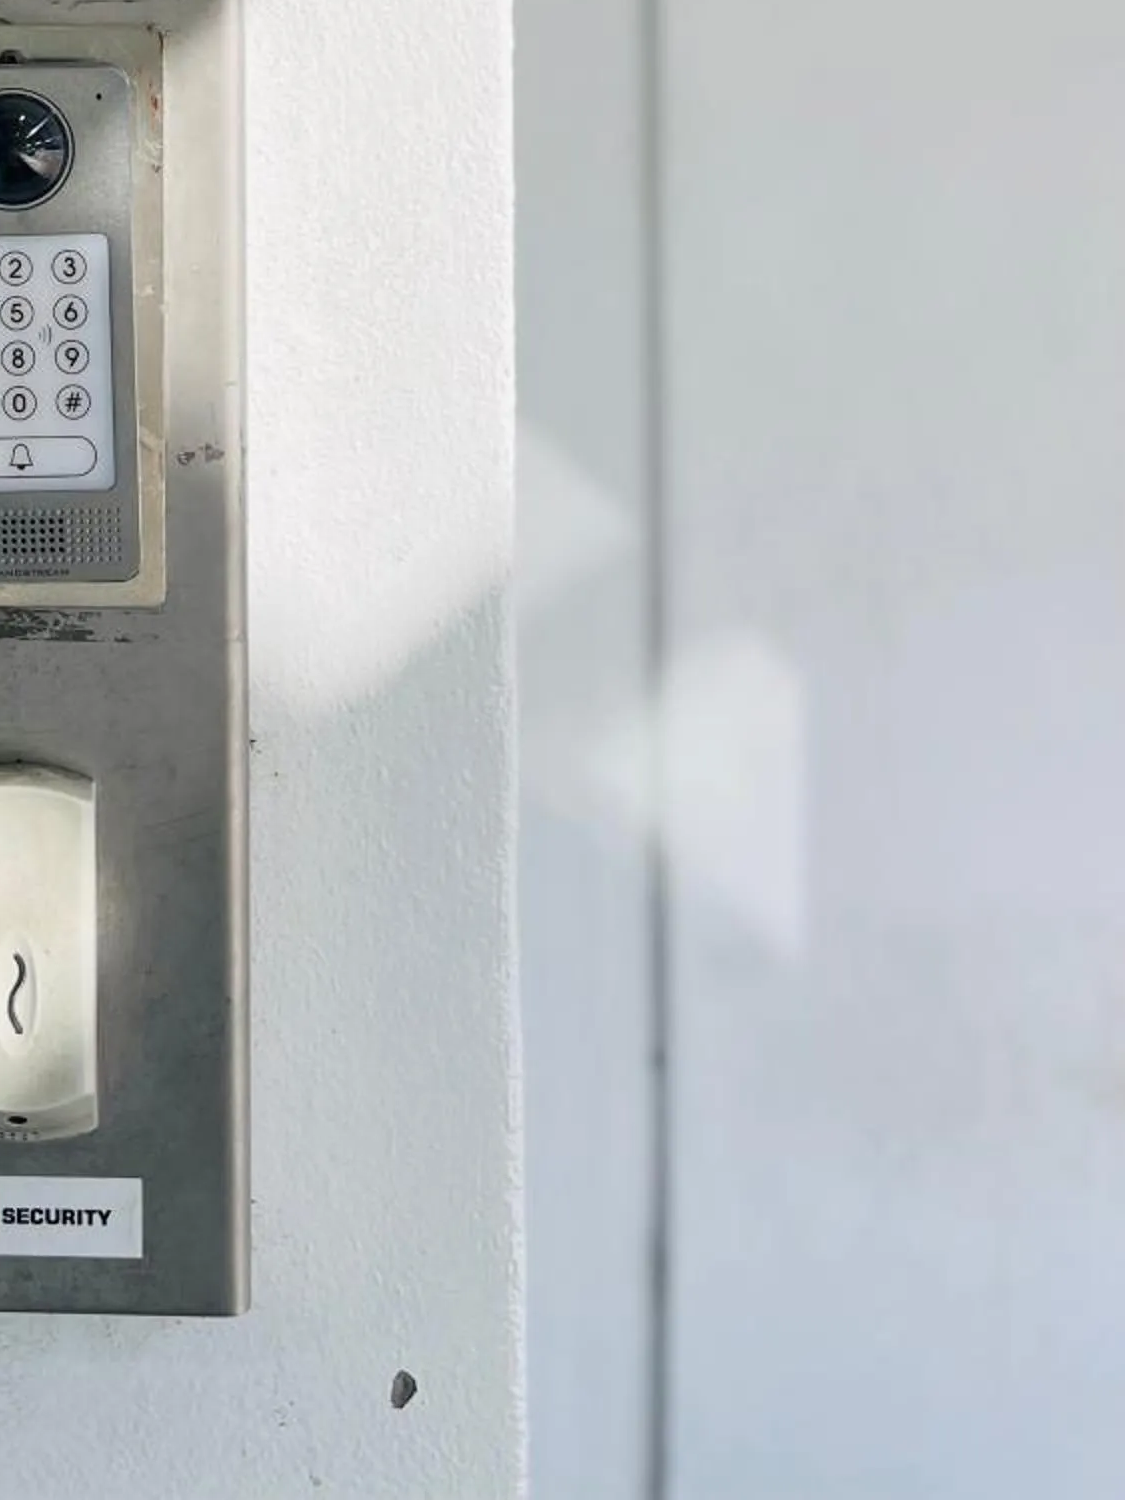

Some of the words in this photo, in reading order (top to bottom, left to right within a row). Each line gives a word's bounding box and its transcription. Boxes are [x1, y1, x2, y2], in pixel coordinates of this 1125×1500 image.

[7, 257, 22, 279] 2
[63, 256, 76, 278] 3
[10, 303, 24, 323] 5
[64, 301, 78, 323] 6
[12, 347, 25, 369] 8
[64, 347, 80, 368] 9
[12, 393, 26, 413] 0
[64, 392, 82, 413] #
[1, 1206, 112, 1227] SECURITY
